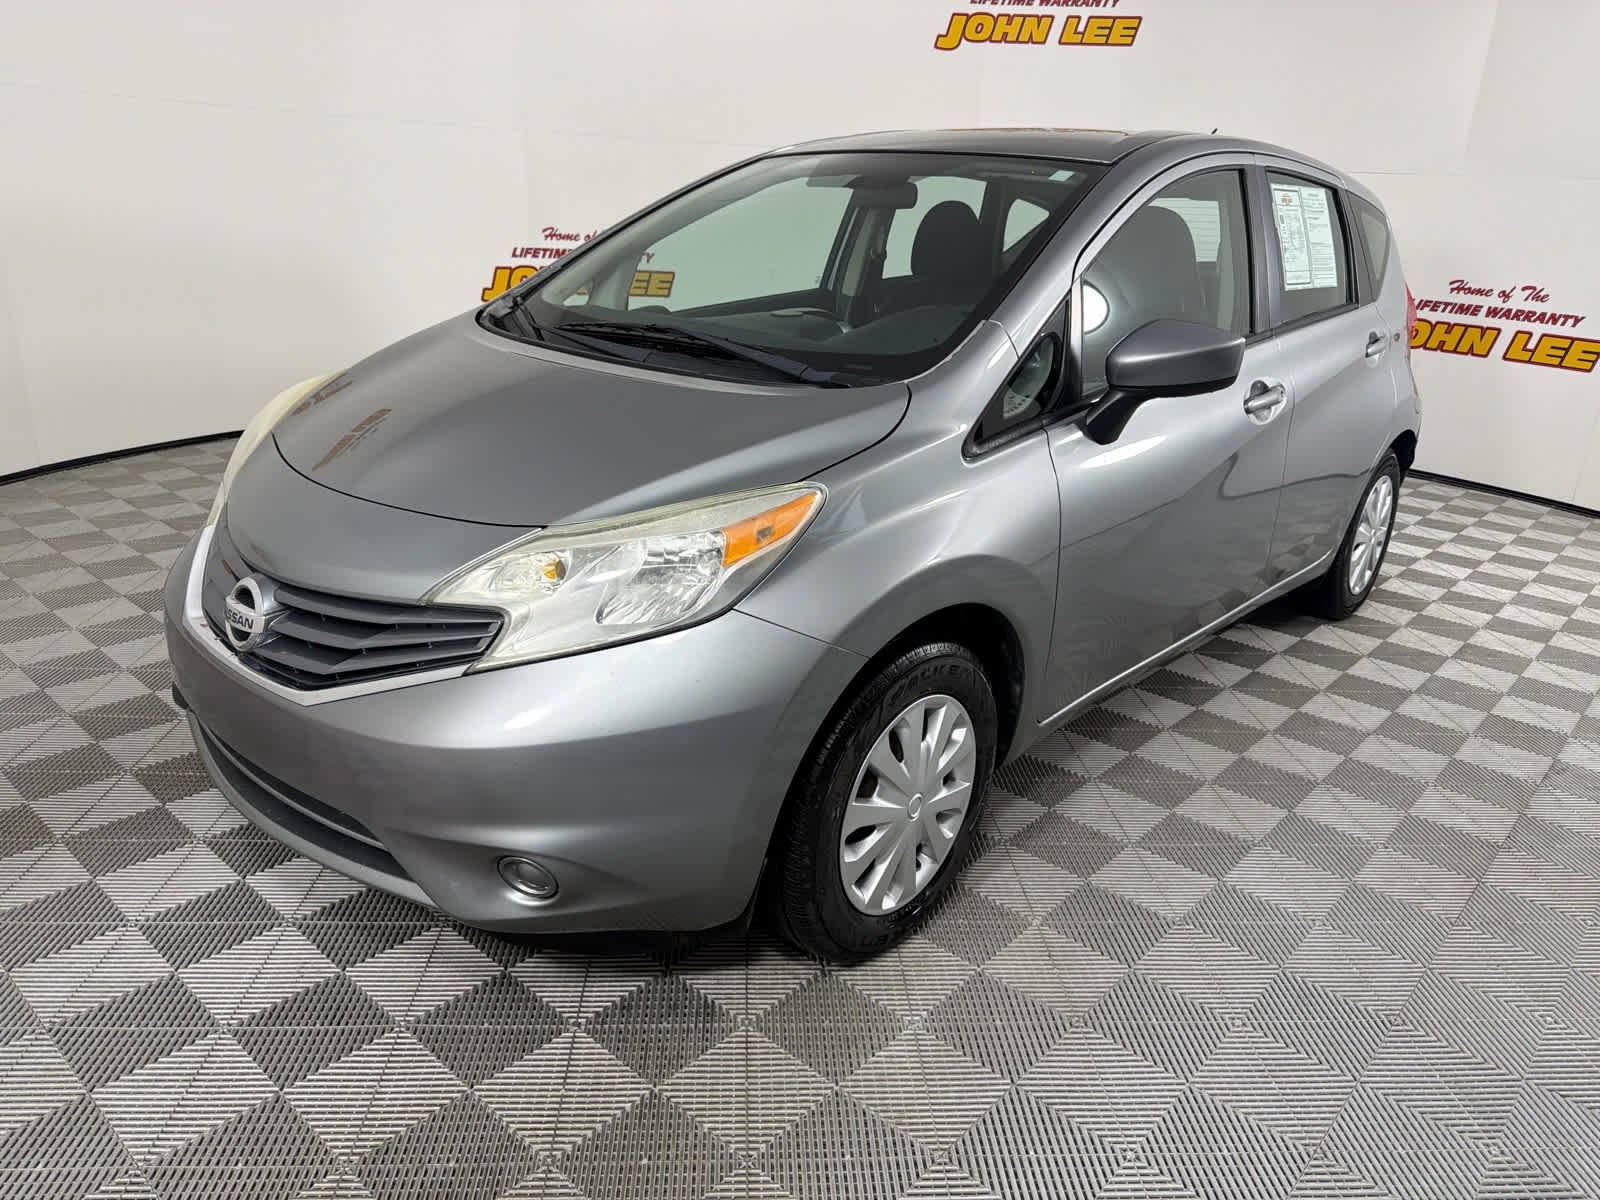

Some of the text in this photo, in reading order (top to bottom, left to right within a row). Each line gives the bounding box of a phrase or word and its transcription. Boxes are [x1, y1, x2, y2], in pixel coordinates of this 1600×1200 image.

[934, 12, 1143, 50] JOHN LEE
[542, 226, 580, 242] Home
[511, 247, 571, 259] LIFETIM
[629, 270, 675, 297] EE
[1448, 279, 1550, 304] Home of The
[1485, 306, 1586, 328] WARRANTY
[1409, 318, 1600, 373] OHN LEE
[225, 608, 254, 630] SSAN
